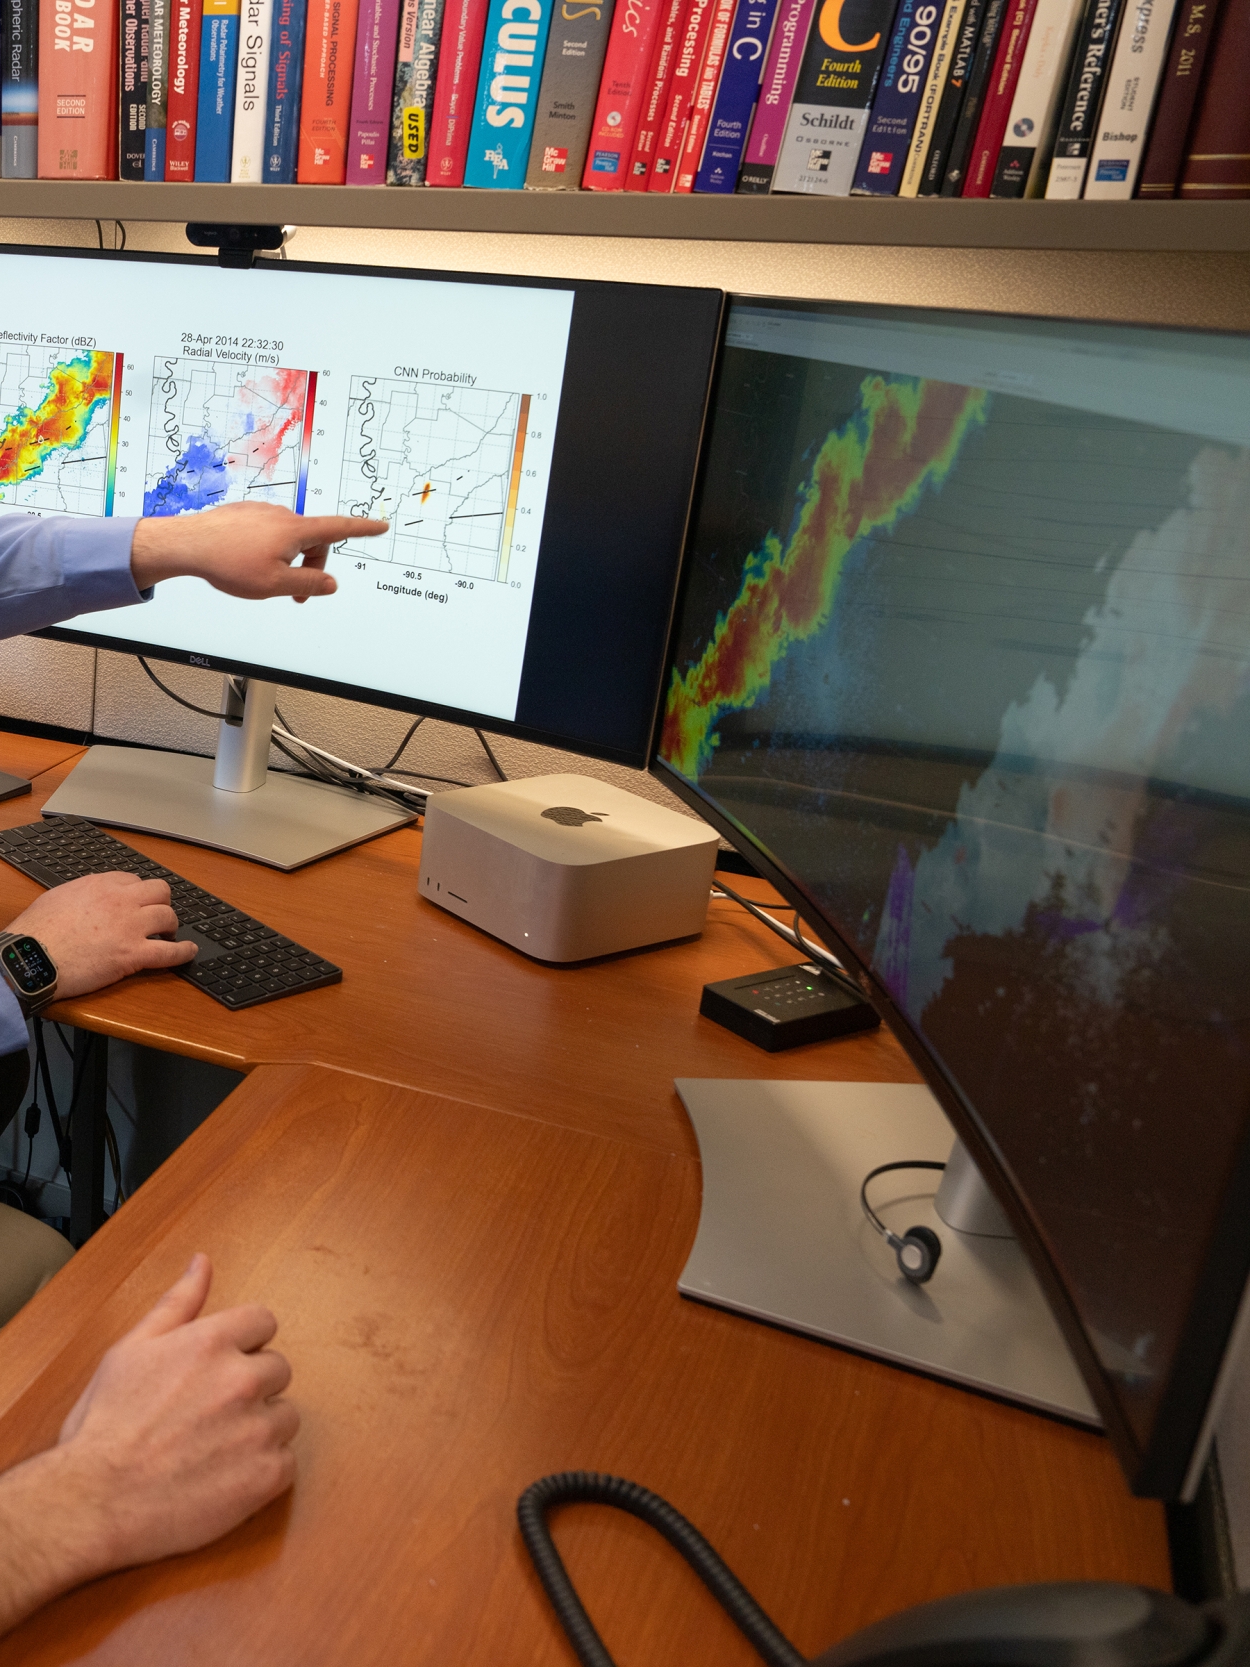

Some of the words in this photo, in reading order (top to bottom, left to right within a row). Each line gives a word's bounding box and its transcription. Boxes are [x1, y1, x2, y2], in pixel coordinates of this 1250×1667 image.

[54, 1, 73, 52] BOOK
[330, 2, 341, 38] SIGNAL
[746, 11, 766, 28] in
[938, 5, 958, 52] Example
[220, 20, 229, 39] Radar
[280, 31, 292, 46] of
[403, 12, 416, 49] Version
[210, 20, 218, 61] Observations
[563, 40, 588, 48] Second
[707, 23, 727, 66] FORMULAS
[732, 37, 763, 61] C
[898, 5, 937, 93] 90/95
[125, 19, 138, 92] Observations
[174, 8, 191, 94] Meteorology
[217, 40, 228, 76] Polarimetry
[370, 40, 380, 75] Stochastic
[562, 48, 586, 56] Edition
[884, 17, 911, 87] Engineers
[952, 26, 976, 77] MATLAB
[11, 44, 22, 82] Radar
[151, 19, 164, 105] METEOROLOGY
[453, 51, 464, 85] Problems
[486, 0, 542, 128] CULUS
[656, 44, 672, 79] Random
[821, 58, 863, 74] Fourth
[932, 53, 946, 81] Book
[1176, 48, 1196, 76] 2011
[241, 35, 263, 111] Signals
[275, 51, 291, 99] Signals
[326, 41, 338, 107] PROCESSING
[413, 42, 435, 109] Algebra
[816, 74, 859, 89] Edition
[607, 88, 631, 96] Edition
[612, 80, 631, 88] Tenth
[951, 79, 963, 88] 7
[1070, 43, 1105, 132] Reference
[57, 99, 86, 107] SECOND
[216, 87, 225, 115] Weather
[368, 78, 377, 111] Processes
[647, 81, 663, 121] Processes
[1120, 79, 1132, 110] EDITION
[56, 107, 85, 115] EDITION
[553, 101, 575, 110] Smith
[129, 104, 137, 131] EDITION
[549, 111, 576, 121] Minton
[717, 119, 742, 129] Fourth
[799, 112, 856, 131] Schildt
[877, 116, 907, 125] Second
[913, 84, 939, 153] (FORTRAN)
[272, 123, 281, 147] Edition
[408, 113, 419, 153] USED
[713, 129, 740, 139] Edition
[872, 125, 907, 134] Edition
[1102, 132, 1138, 142] Bishop
[795, 135, 851, 148] OSBORNE
[543, 157, 567, 165] Graw
[545, 147, 558, 156] Mc
[542, 163, 555, 172] Hill
[40, 334, 69, 345] Factor
[71, 336, 97, 349] (dBZ)
[181, 333, 213, 346] 28-Apr
[215, 336, 239, 347] 2014
[241, 338, 284, 351] 22:32:30
[183, 345, 213, 358] Radial
[216, 348, 252, 363] Velocity
[254, 352, 280, 366] (m/s)
[127, 363, 135, 371] 60
[394, 366, 419, 378] CNN
[421, 369, 477, 386] Probability
[536, 393, 548, 401] 1.0
[531, 431, 542, 439] 0.8
[525, 469, 537, 477] 0.6
[521, 507, 531, 515] 0.4
[515, 544, 527, 552] 0.2
[355, 562, 366, 571] -91
[403, 571, 422, 581] -90.5
[376, 581, 422, 598] Longitude
[424, 591, 449, 604] (deg)
[455, 580, 475, 590] -90.0
[510, 581, 522, 589] 0.0
[189, 655, 210, 667] DELL
